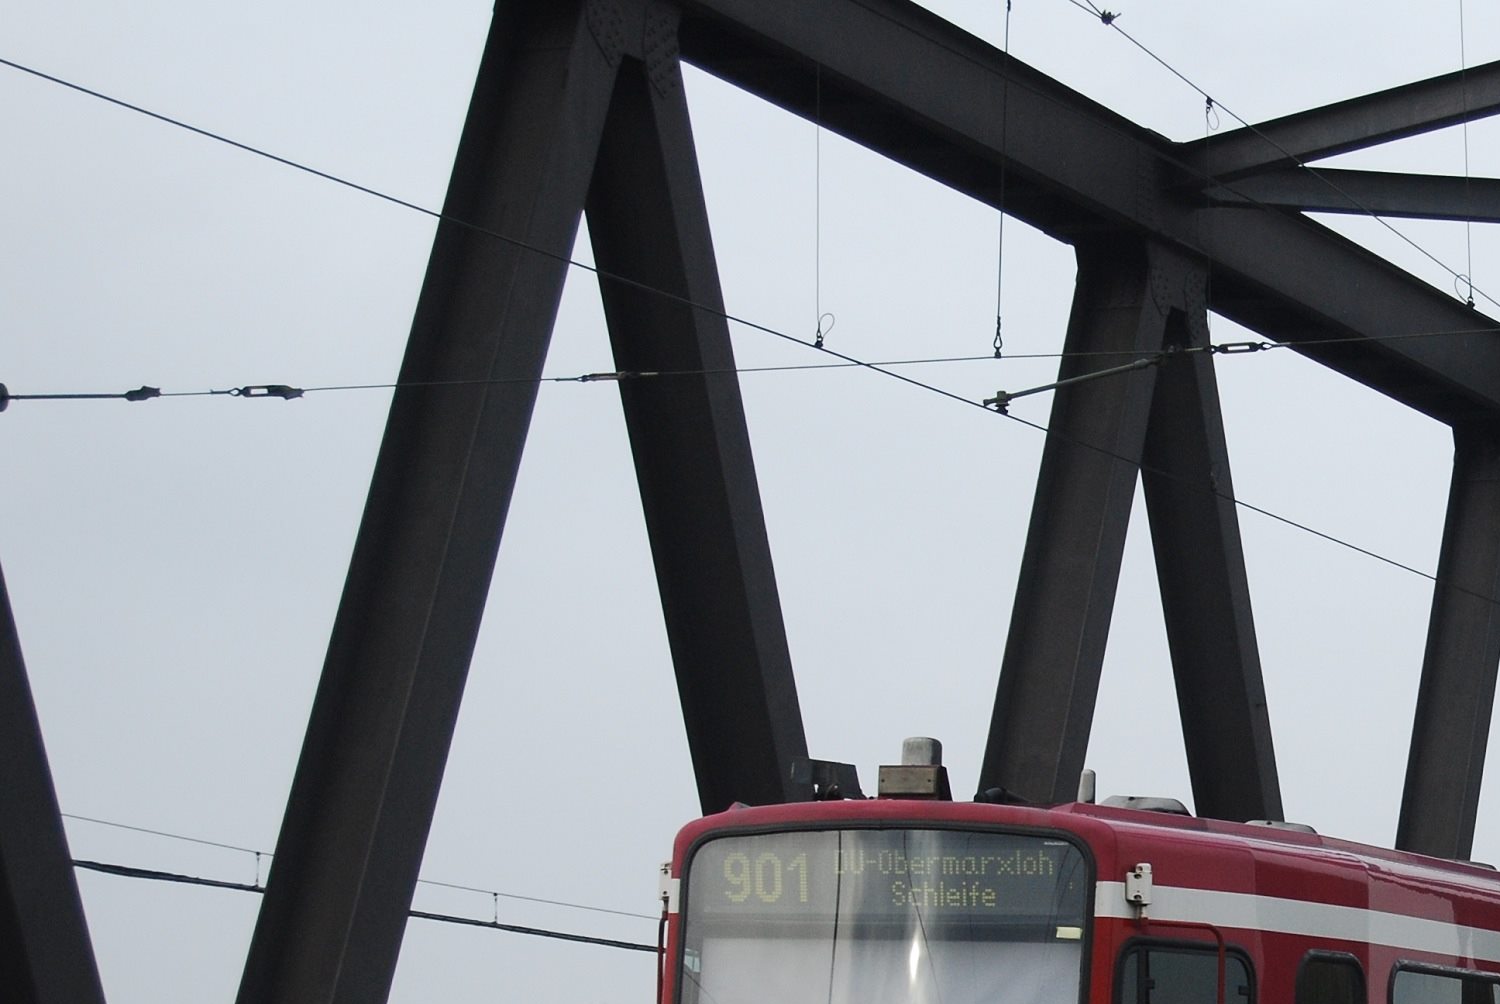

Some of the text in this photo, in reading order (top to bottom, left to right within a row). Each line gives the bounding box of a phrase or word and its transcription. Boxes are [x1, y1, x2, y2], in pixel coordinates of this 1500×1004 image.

[723, 849, 1054, 903] 901 DU-Obermarxloh
[892, 880, 997, 907] Schleife
